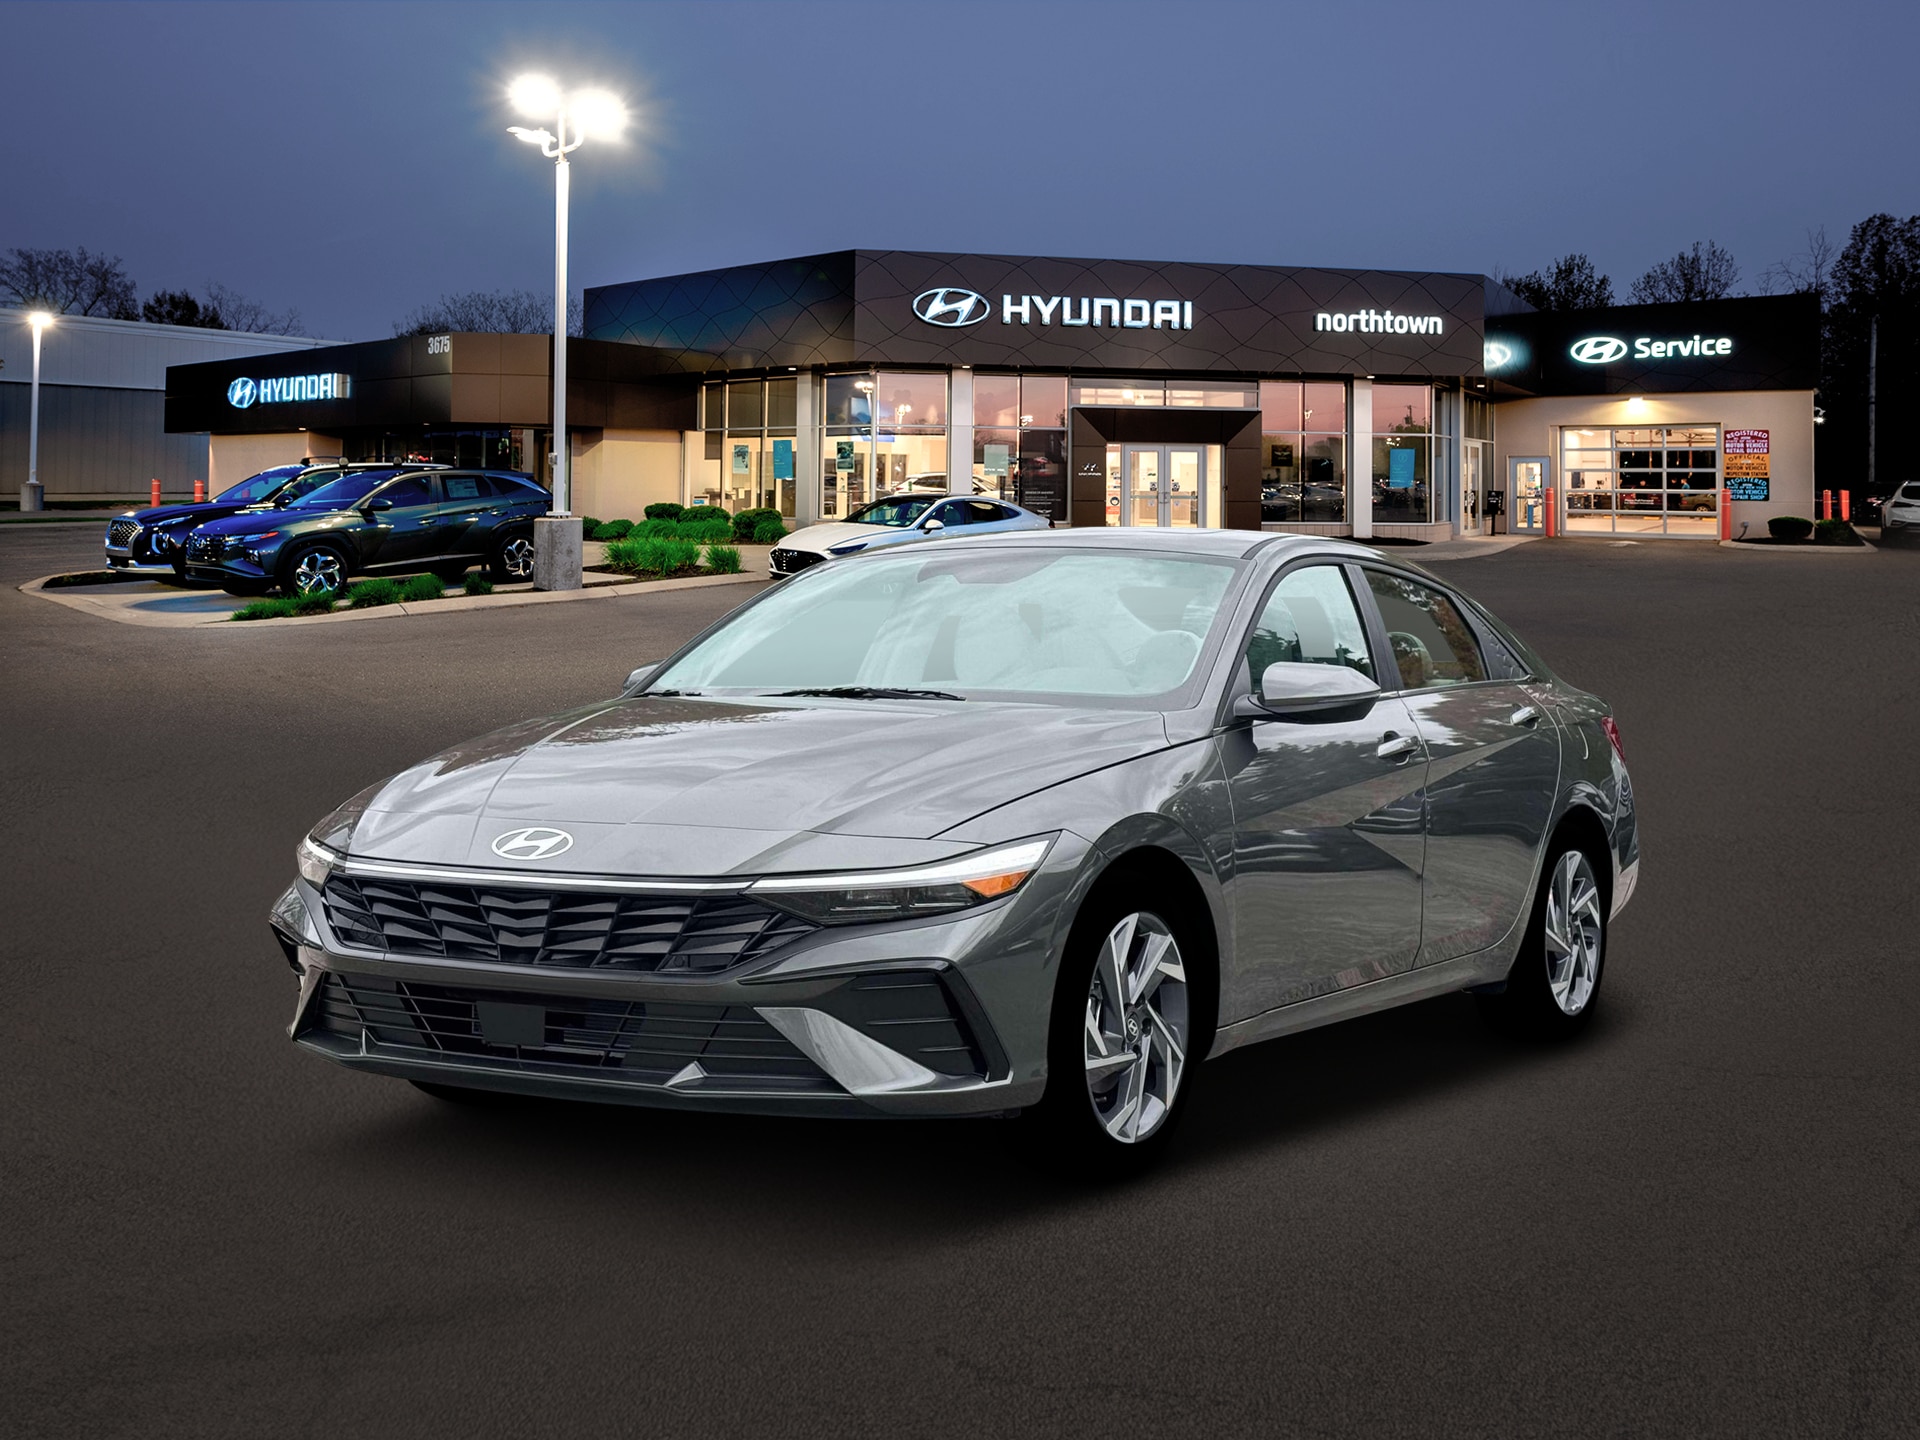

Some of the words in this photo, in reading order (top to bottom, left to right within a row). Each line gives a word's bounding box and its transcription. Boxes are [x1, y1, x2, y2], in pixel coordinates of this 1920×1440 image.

[1002, 294, 1193, 330] HYUNDAI
[1316, 309, 1443, 334] northtown
[428, 335, 450, 354] 3675
[1634, 335, 1732, 358] Service
[260, 373, 339, 403] HYUNDAI
[1726, 430, 1768, 439] REGISTERED
[1726, 478, 1767, 486] REGISTERED
